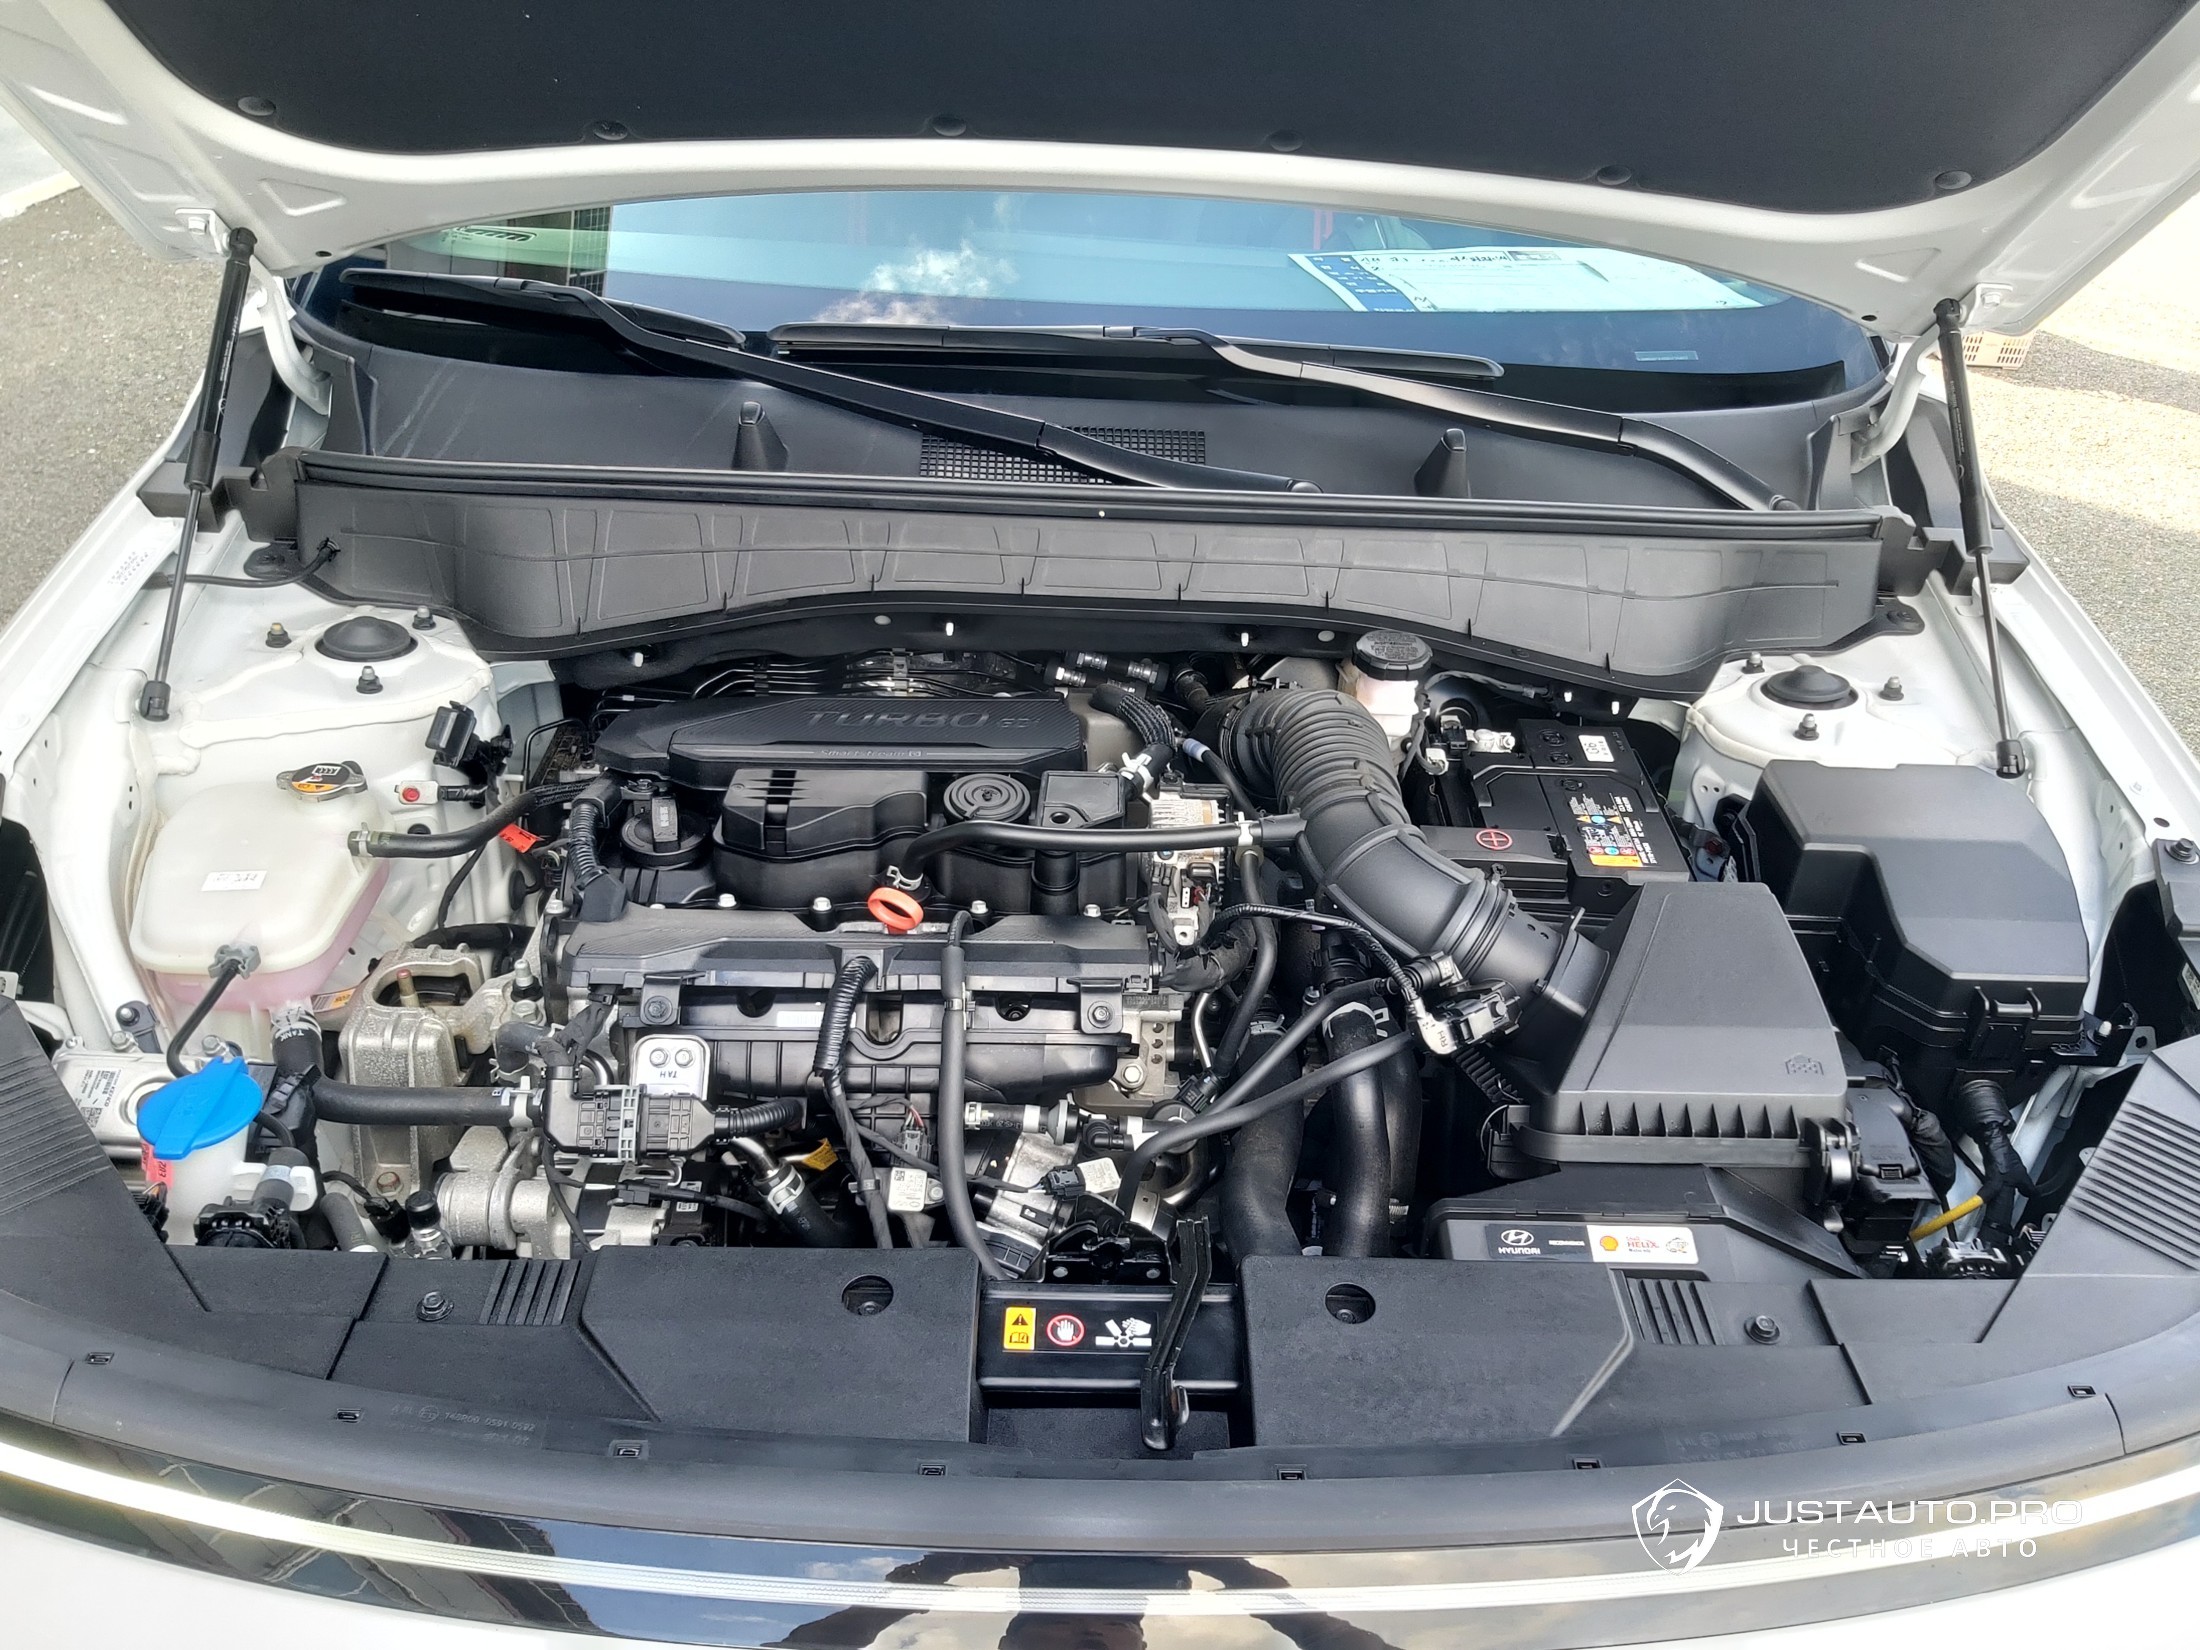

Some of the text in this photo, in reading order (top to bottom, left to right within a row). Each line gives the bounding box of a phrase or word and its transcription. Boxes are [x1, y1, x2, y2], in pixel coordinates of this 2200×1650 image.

[803, 711, 990, 728] TURBO
[1627, 1239, 1660, 1248] HELIX
[1498, 1246, 1541, 1255] HYUNDAI
